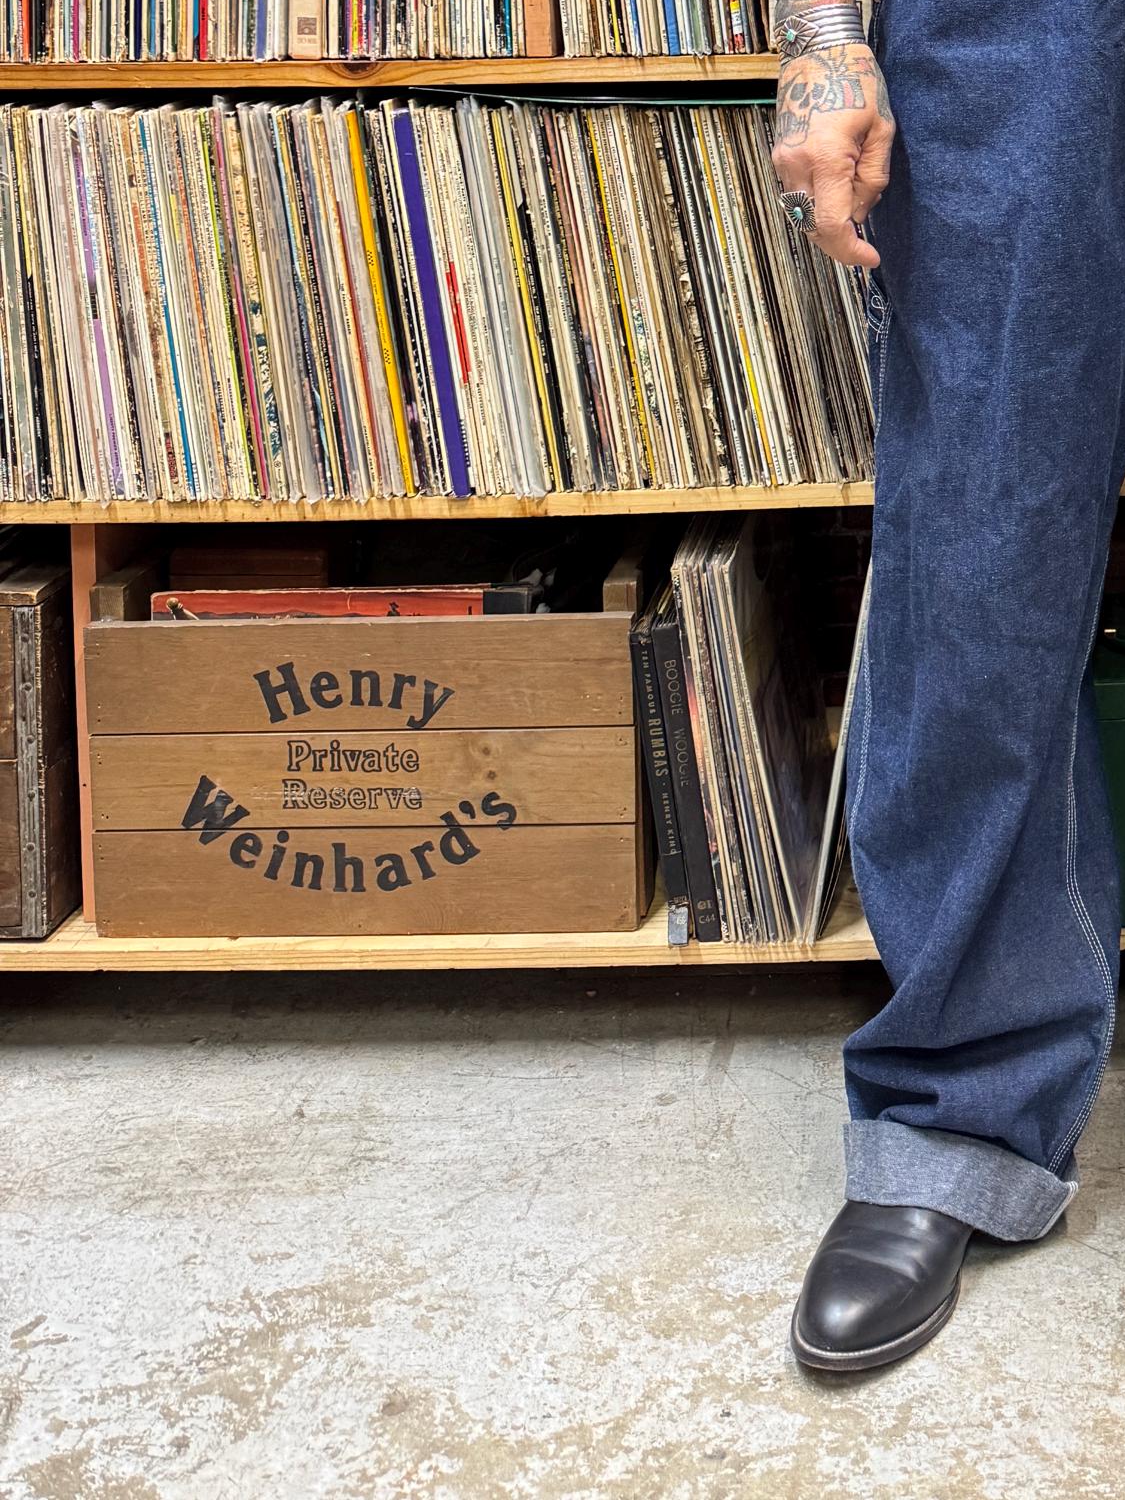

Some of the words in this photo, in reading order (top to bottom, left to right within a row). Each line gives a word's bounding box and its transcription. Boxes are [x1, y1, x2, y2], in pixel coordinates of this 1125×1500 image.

[640, 651, 650, 668] TEN
[253, 661, 456, 729] Henry
[643, 674, 656, 714] FAMOUS
[663, 659, 684, 715] BOOGIE
[674, 728, 690, 788] WOOGIE
[286, 739, 420, 773] Private
[648, 718, 668, 778] RUMBAS
[282, 778, 423, 810] Reserve
[661, 792, 672, 826] HENRY
[181, 774, 518, 893] Weinhard's
